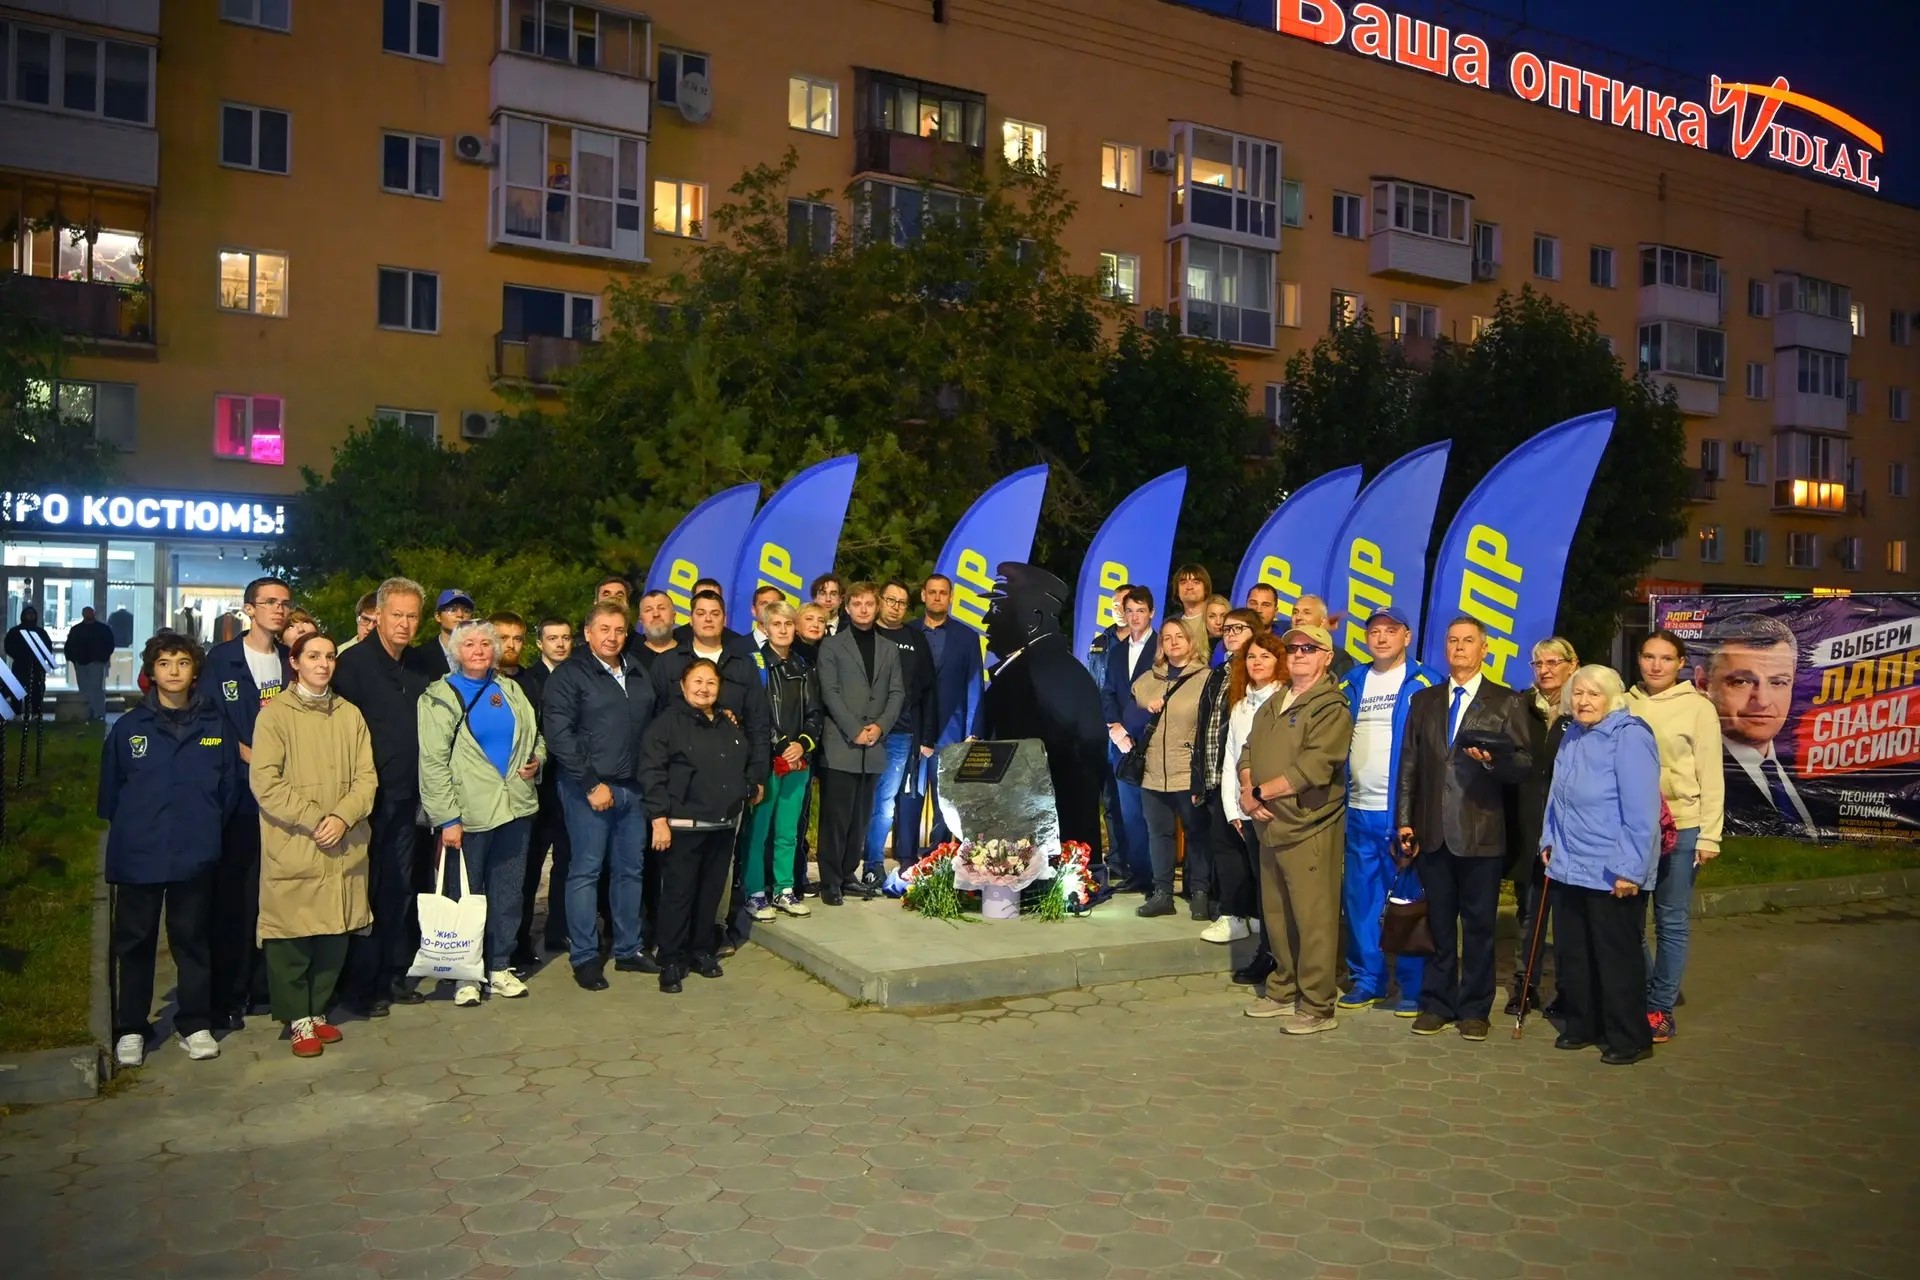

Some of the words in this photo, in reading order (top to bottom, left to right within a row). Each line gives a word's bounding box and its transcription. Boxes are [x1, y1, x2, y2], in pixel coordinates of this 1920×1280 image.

[1510, 51, 1708, 149] оптика
[83, 494, 285, 535] КОСТЮМЫ
[1665, 611, 1693, 621] ЛДПР
[1830, 624, 1912, 660] ВЫБЕРИ
[1813, 694, 1909, 742] СПАСИ
[199, 737, 222, 746] ЛДПР
[1806, 727, 1920, 773] РОССИЮ!
[1839, 790, 1885, 805] ЛЕОНИД
[1839, 805, 1892, 818] СЛУЦКИЙ
